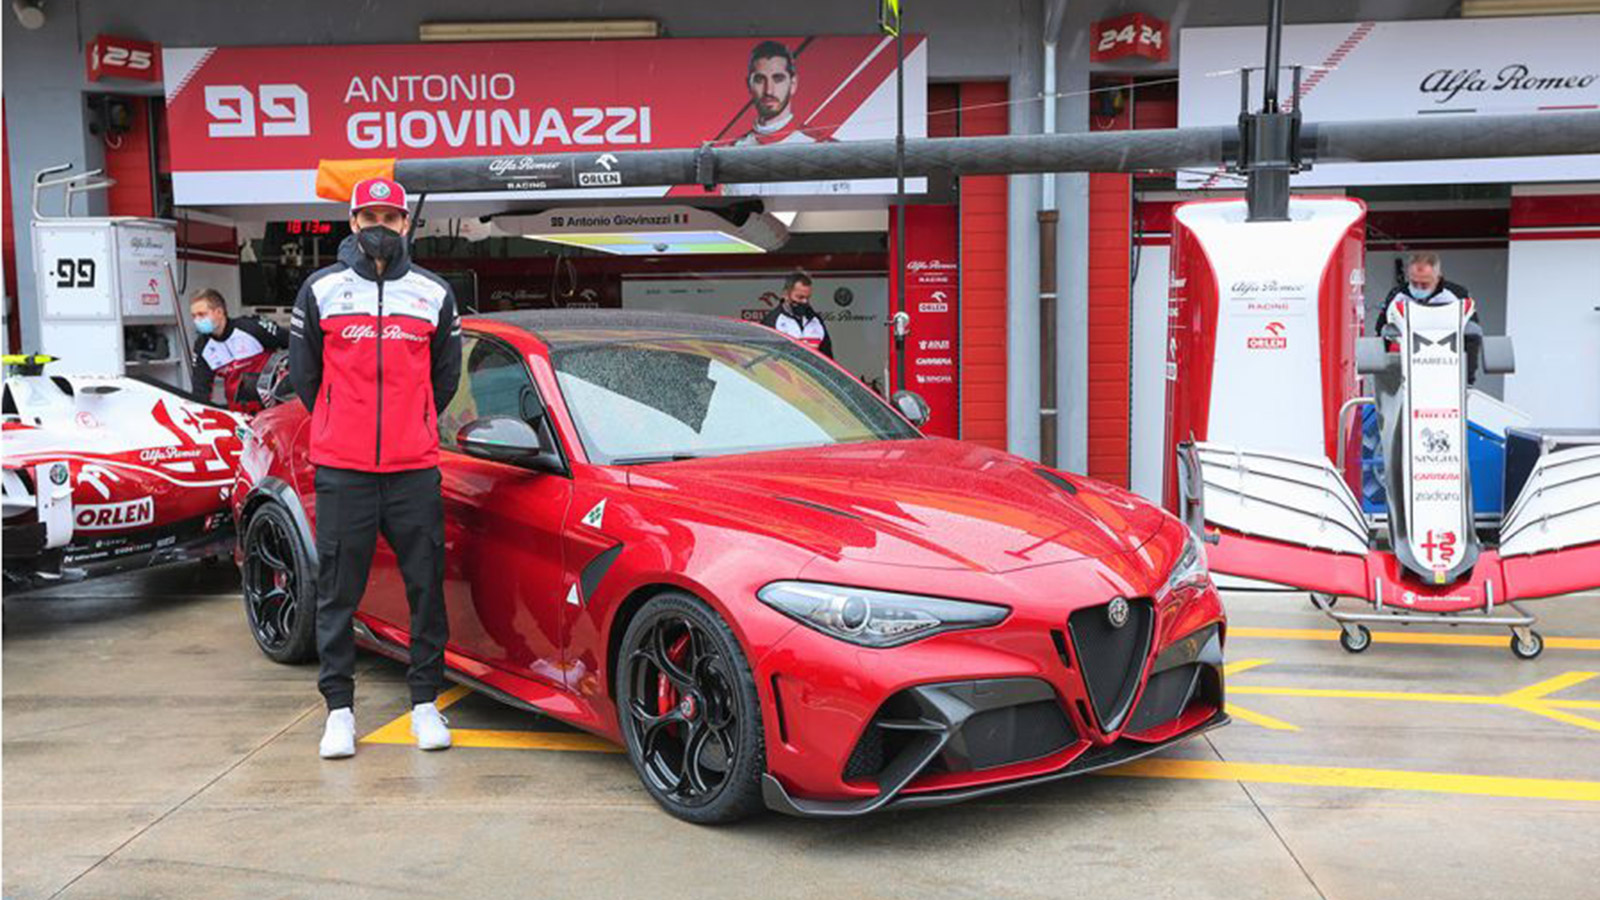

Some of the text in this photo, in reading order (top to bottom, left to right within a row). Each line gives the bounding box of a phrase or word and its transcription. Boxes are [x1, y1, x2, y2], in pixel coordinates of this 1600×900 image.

[1098, 25, 1136, 51] 24
[1141, 25, 1162, 49] 24
[102, 46, 151, 69] 25
[344, 73, 516, 103] ANTONIO
[1419, 64, 1599, 103] Alfa Romeo
[204, 84, 311, 137] 99
[347, 106, 651, 149] GIOVINAZZI
[489, 156, 561, 175] Alfa Romeo
[581, 174, 618, 184] ORLEN
[567, 216, 611, 226] Antonio
[613, 214, 671, 225] Giovinazzi
[57, 258, 95, 287] 99
[1231, 282, 1260, 295] Alfa
[341, 325, 377, 344] Alfa
[1249, 338, 1285, 348] ORLEN
[140, 449, 165, 465] Alfa
[76, 504, 150, 526] ORLEN
